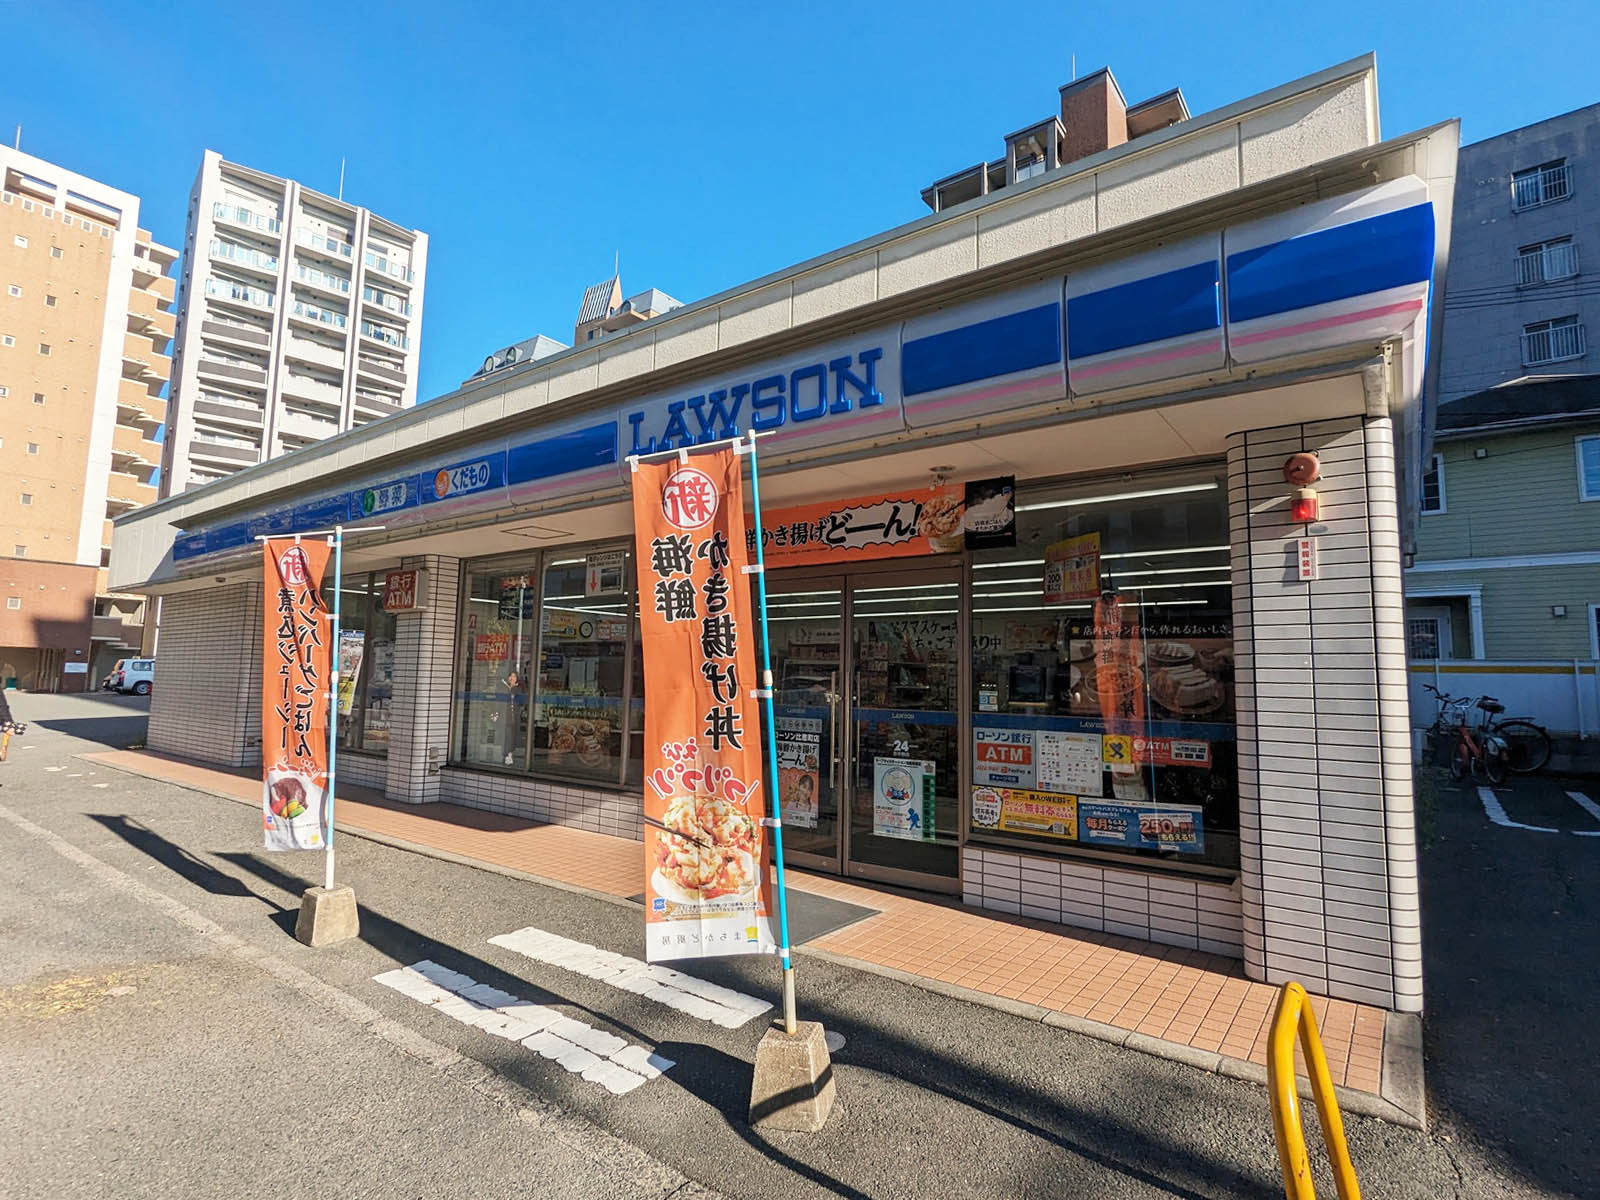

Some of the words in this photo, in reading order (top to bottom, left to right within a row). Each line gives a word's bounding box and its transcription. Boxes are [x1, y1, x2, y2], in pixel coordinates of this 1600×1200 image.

[628, 347, 884, 457] LAWSON
[451, 464, 489, 491] くだもの
[379, 485, 403, 508] 野菜
[389, 574, 412, 590] 銀行
[386, 590, 412, 607] ATM
[976, 731, 1032, 744] ローソン銀行
[894, 740, 909, 751] 24
[1146, 742, 1170, 750] ATM
[985, 746, 1023, 761] ATM
[1086, 817, 1108, 830] 毎月
